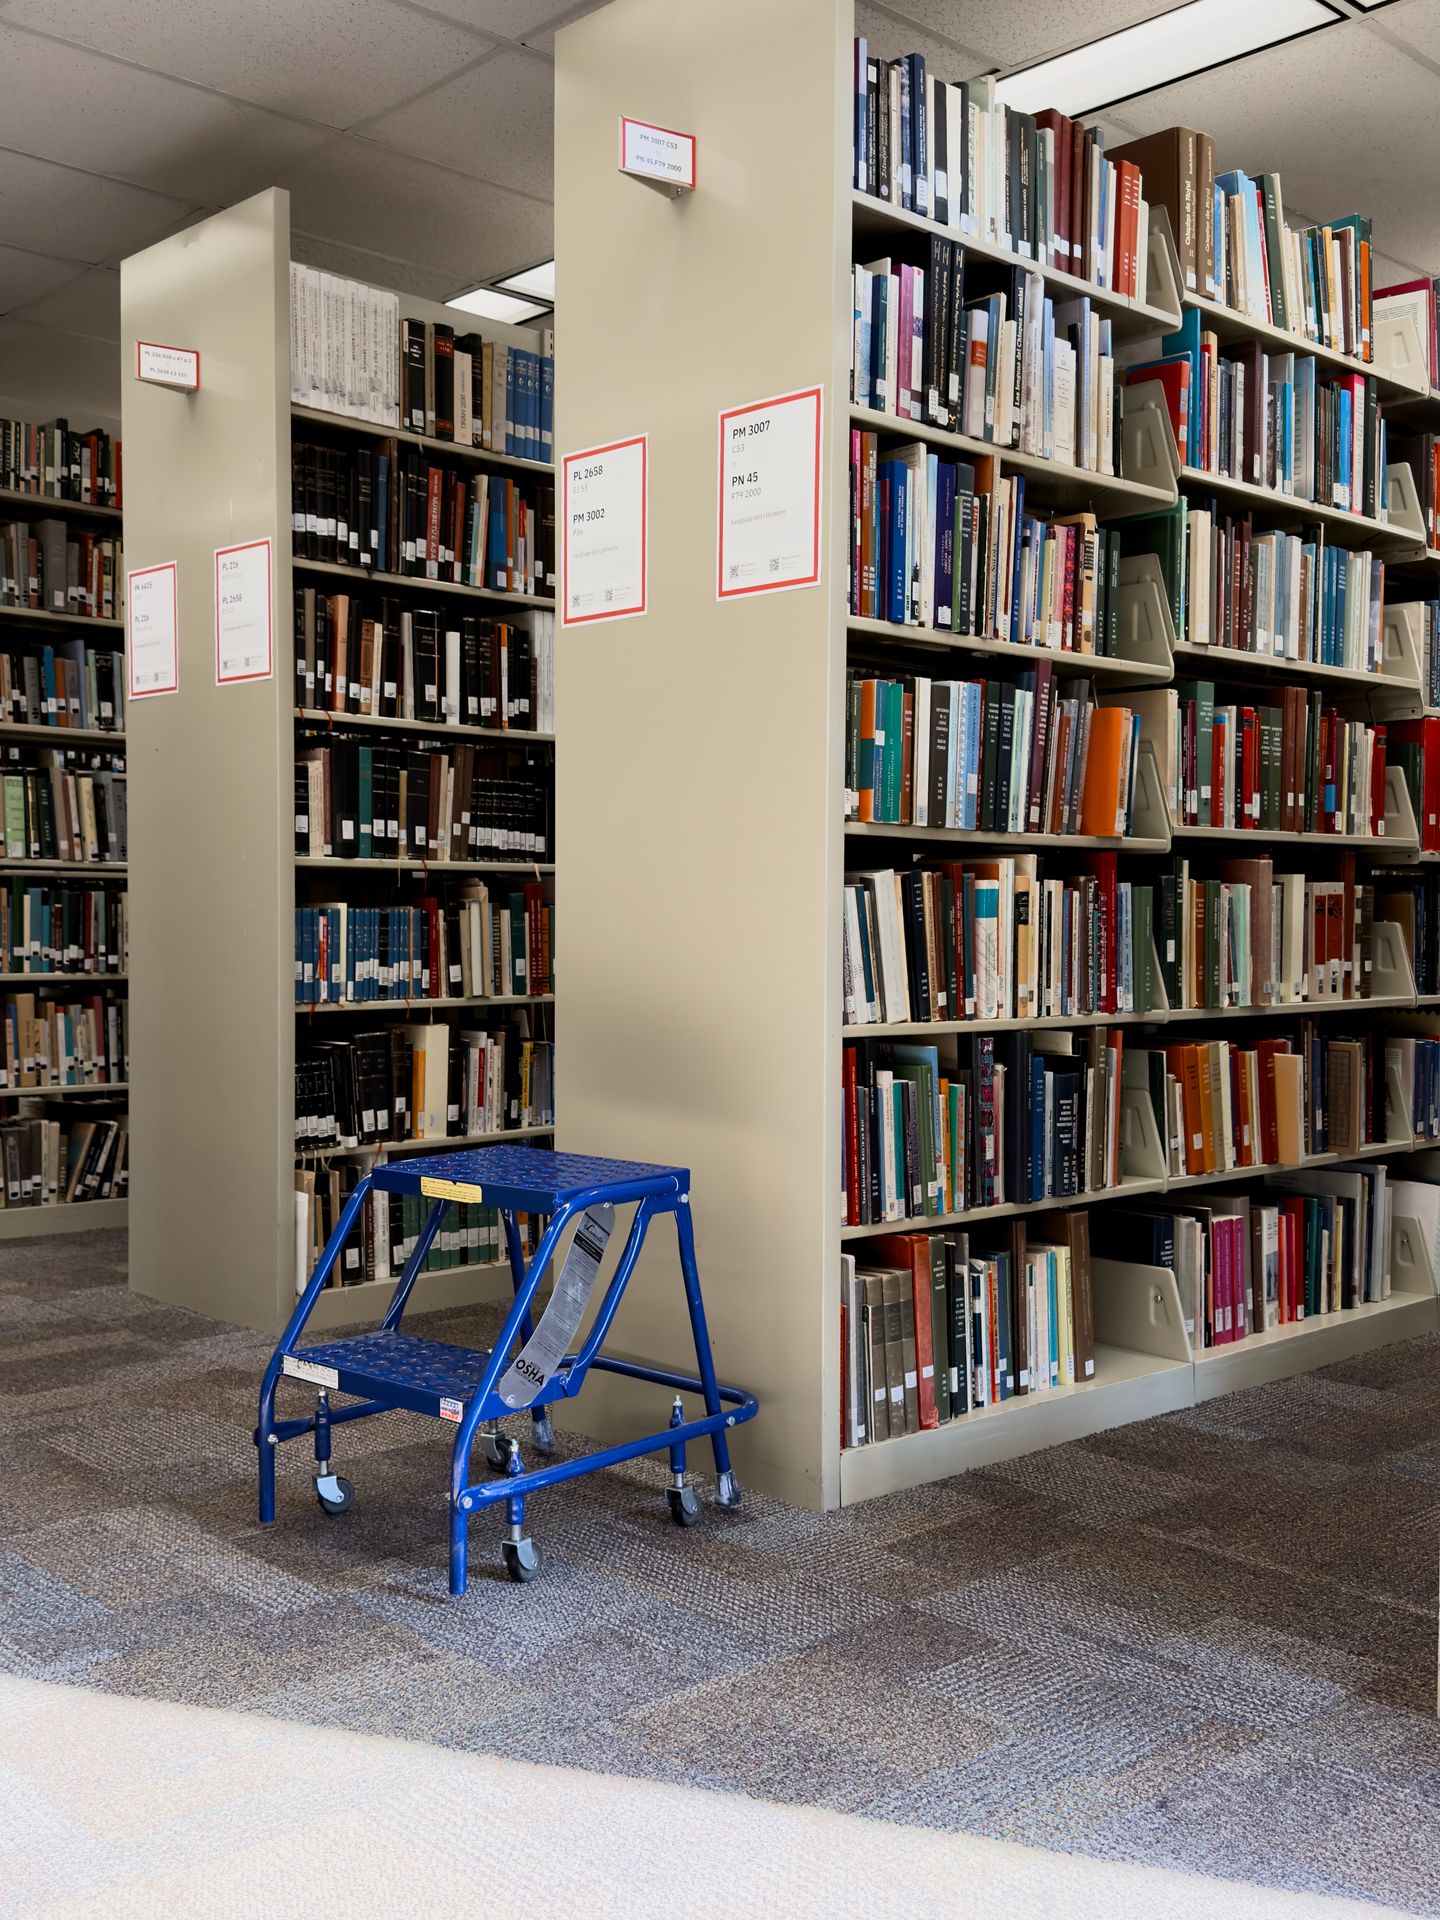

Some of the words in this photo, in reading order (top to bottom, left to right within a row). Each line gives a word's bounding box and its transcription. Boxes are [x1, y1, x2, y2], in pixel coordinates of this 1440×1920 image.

[639, 134, 650, 142] PM
[650, 136, 665, 146] 3007
[635, 154, 646, 163] PN
[732, 425, 747, 441] PM
[747, 419, 771, 437] 3007
[731, 442, 746, 455] C53
[572, 470, 583, 481] PL
[583, 464, 604, 480] 2658
[731, 474, 746, 487] PN
[746, 470, 759, 485] 45
[572, 512, 585, 525] PM
[585, 507, 606, 522] 3002
[222, 595, 229, 605] PL
[1088, 955, 1095, 966] of
[515, 1359, 545, 1386] OSHA
